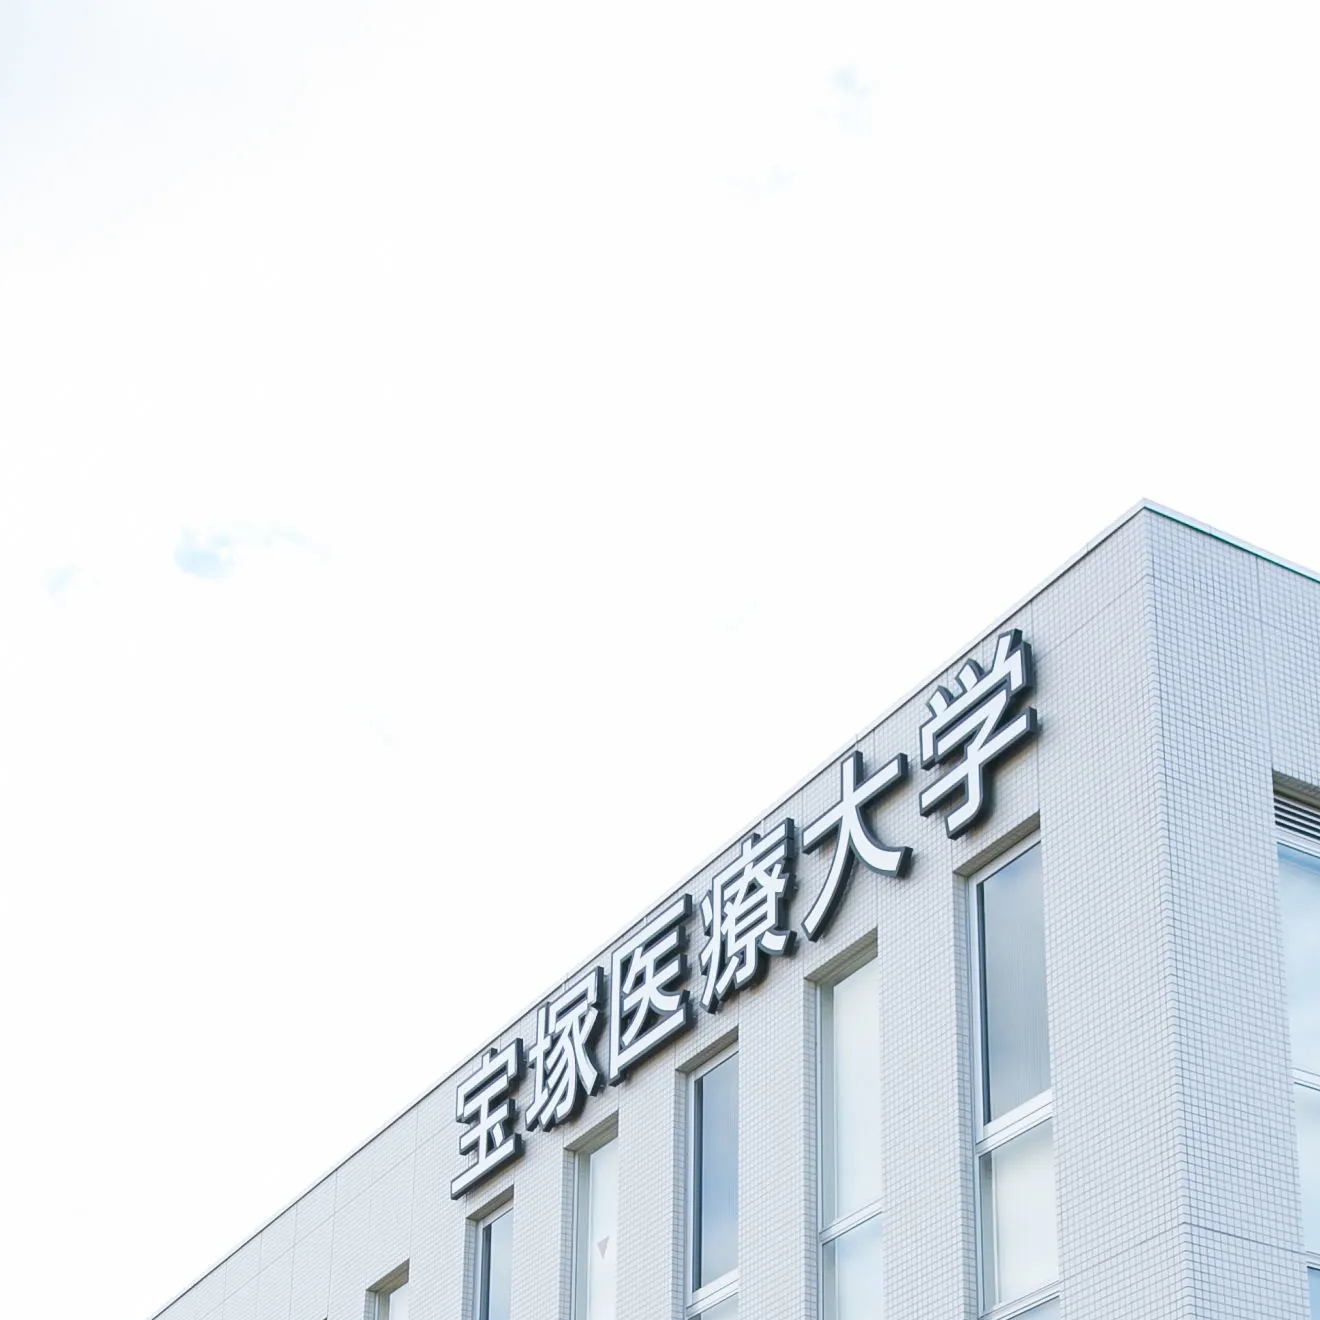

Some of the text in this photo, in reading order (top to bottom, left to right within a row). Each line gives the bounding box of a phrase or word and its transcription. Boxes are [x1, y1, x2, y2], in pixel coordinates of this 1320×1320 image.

[450, 627, 1038, 1200] 宝塚医療大学
